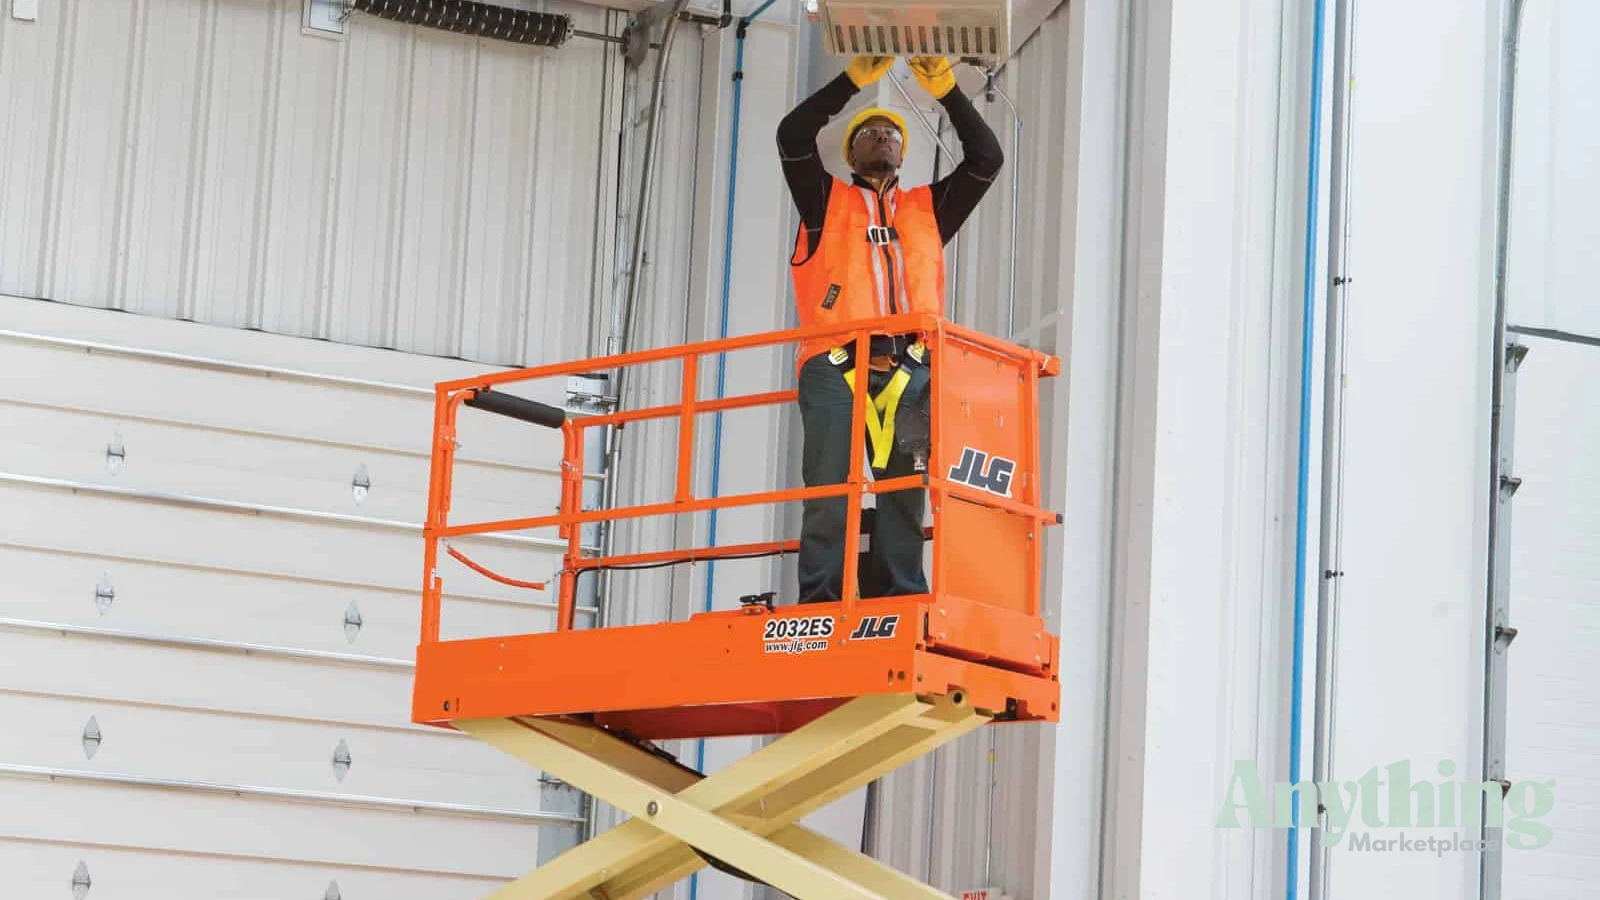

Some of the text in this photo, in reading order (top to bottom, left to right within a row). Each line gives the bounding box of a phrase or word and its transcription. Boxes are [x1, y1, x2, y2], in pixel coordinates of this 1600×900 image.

[948, 446, 1016, 496] JLG
[764, 617, 833, 638] 2032ES
[851, 616, 899, 639] JLG
[765, 640, 827, 653] www.jlg.com
